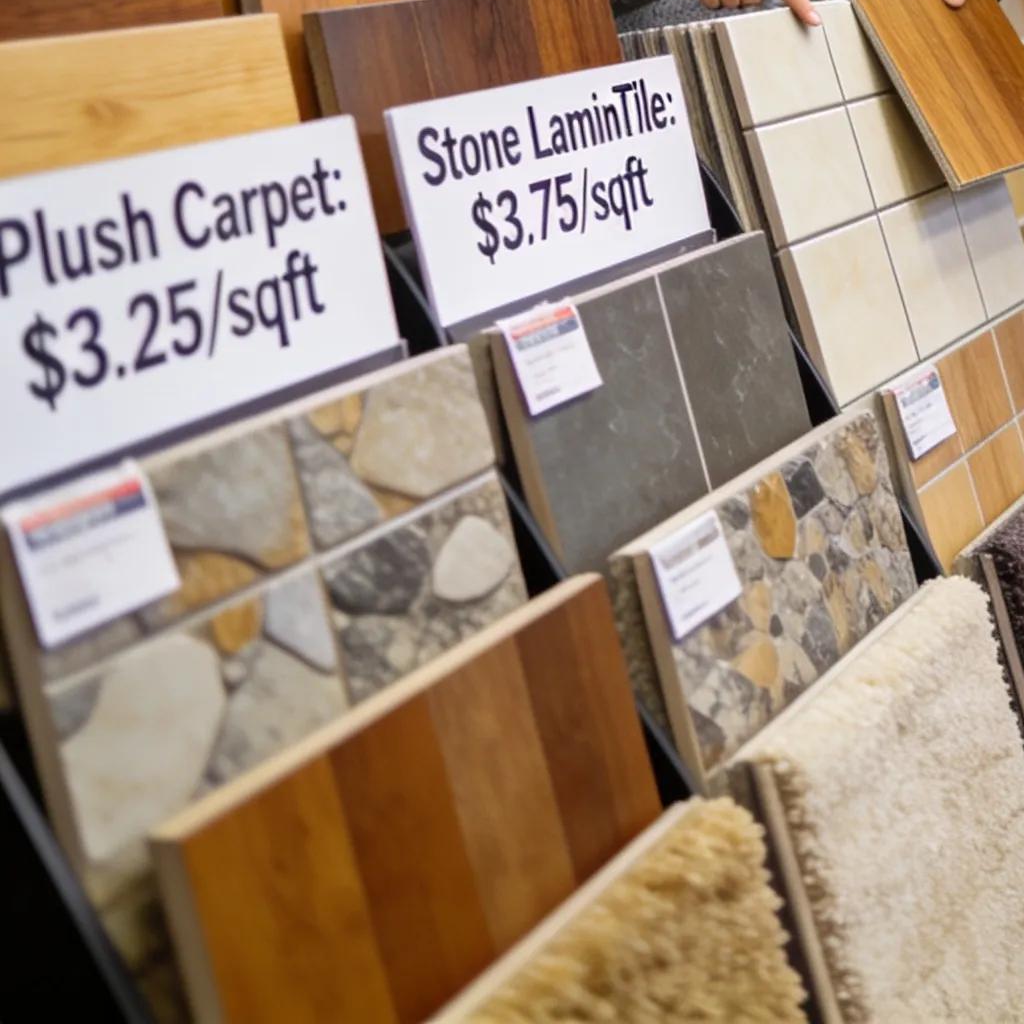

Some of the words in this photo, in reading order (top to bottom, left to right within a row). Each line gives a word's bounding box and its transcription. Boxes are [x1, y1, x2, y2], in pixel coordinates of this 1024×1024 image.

[417, 125, 522, 187] Stone
[527, 80, 677, 160] LaminTile:
[0, 193, 159, 300] Plush
[173, 158, 348, 250] Carpet:
[471, 155, 654, 265] $3.75/sqft
[21, 249, 325, 412] $3.25/sqft
